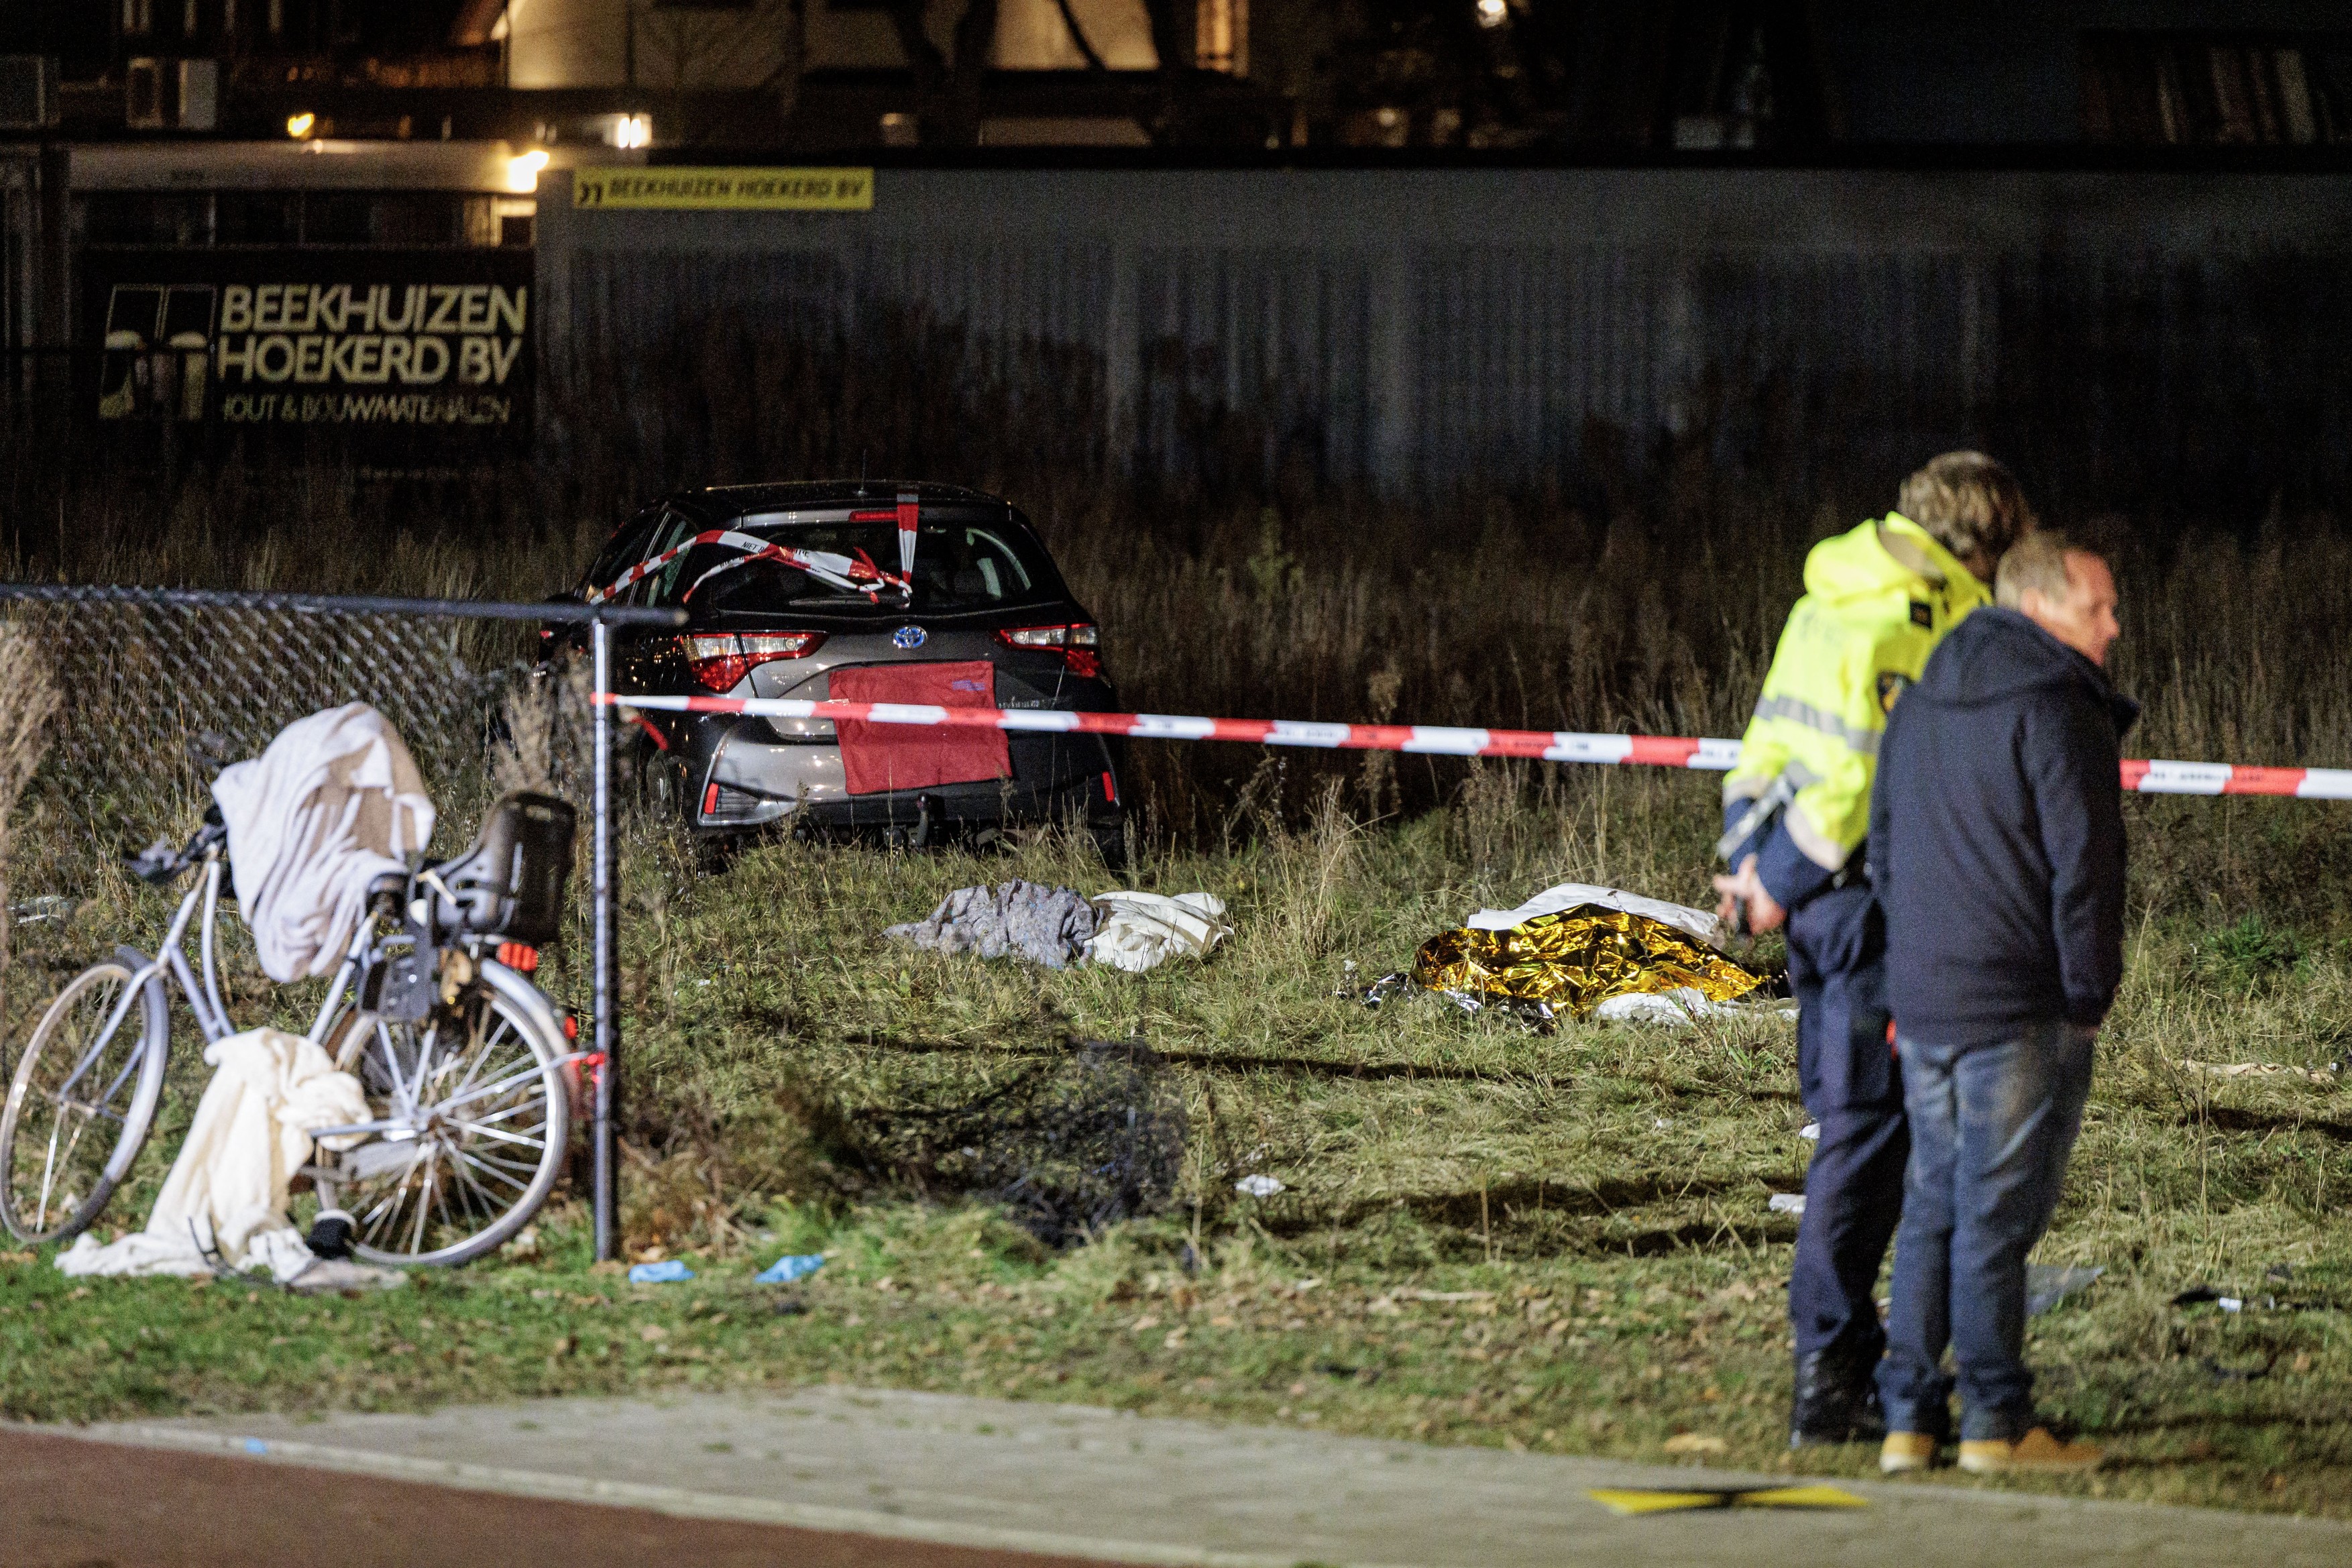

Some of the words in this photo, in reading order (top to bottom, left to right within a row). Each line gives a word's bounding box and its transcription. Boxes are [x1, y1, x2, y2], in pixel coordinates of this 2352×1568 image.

[220, 284, 527, 334] BEEKHUIZEN
[217, 335, 450, 384] HOEKERD
[459, 335, 522, 384] BV
[742, 541, 758, 551] NIET
